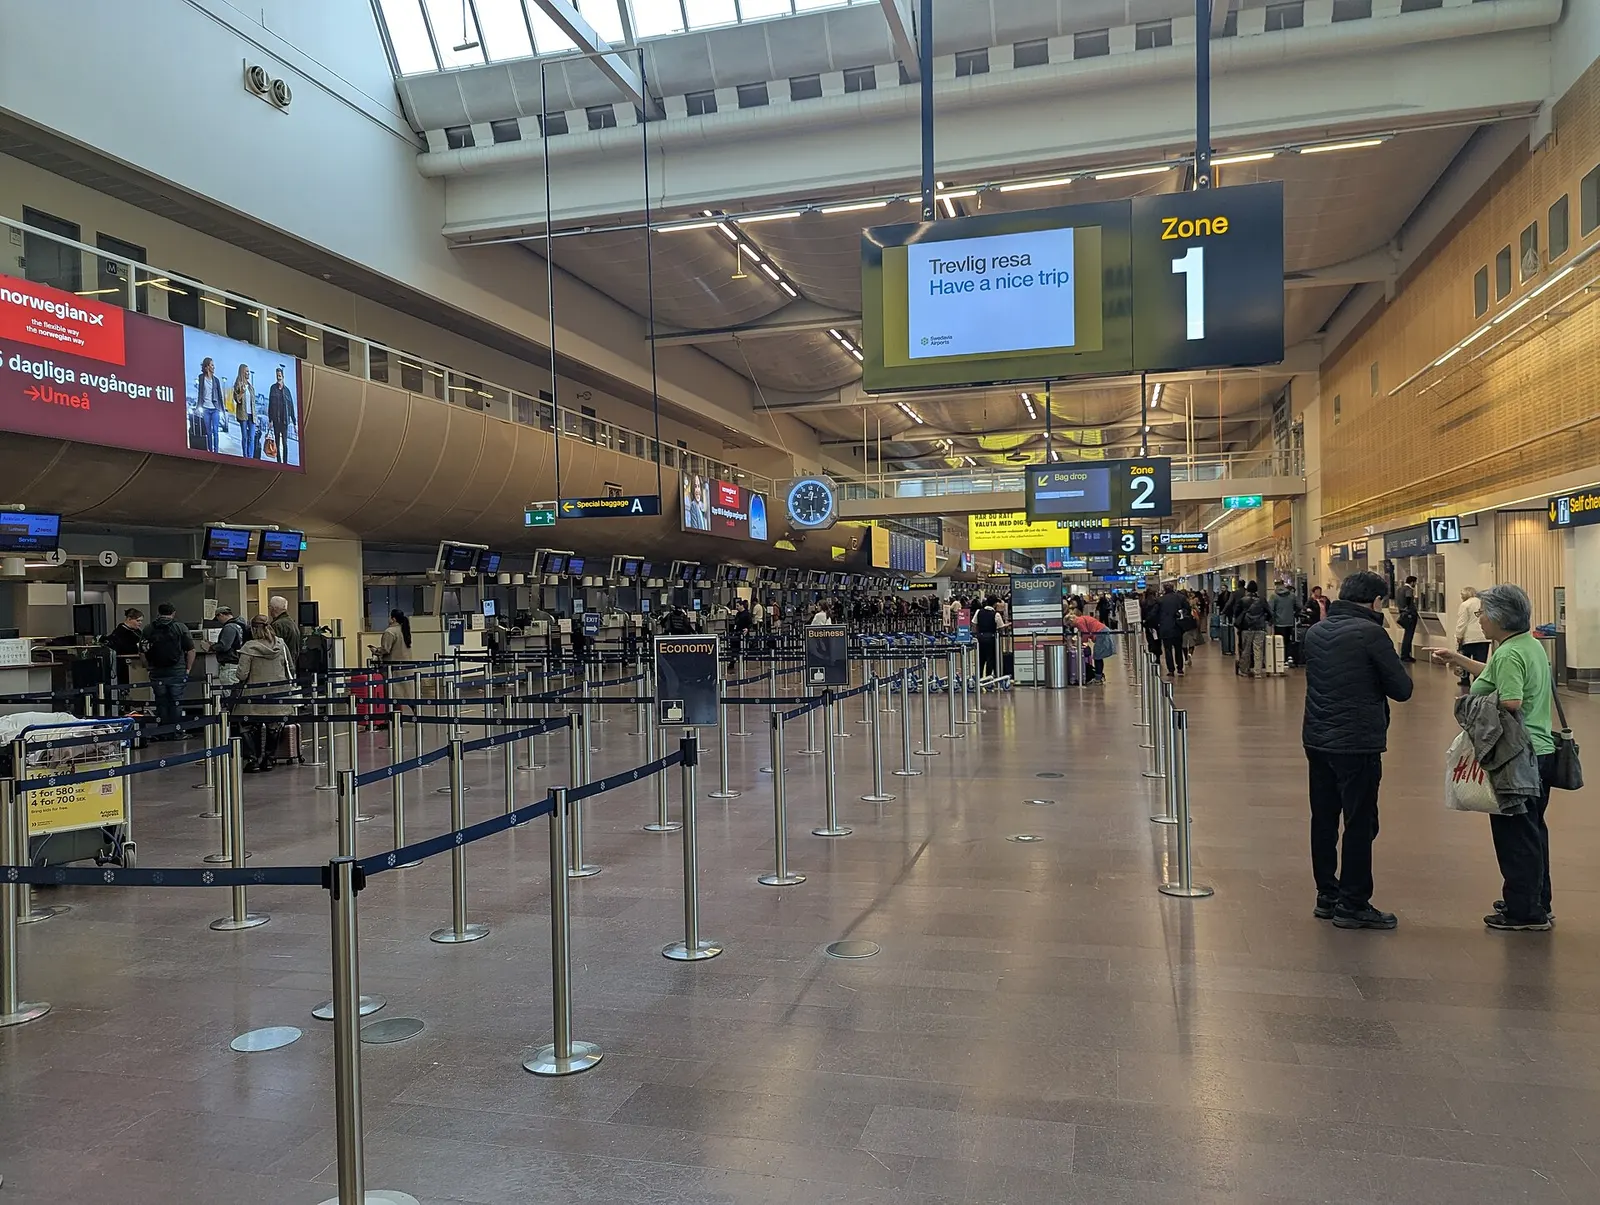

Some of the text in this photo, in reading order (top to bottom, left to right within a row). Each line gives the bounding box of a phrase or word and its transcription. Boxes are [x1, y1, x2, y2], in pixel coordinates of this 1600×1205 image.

[1161, 216, 1228, 241] Zone
[928, 252, 1032, 276] Trevlig resa
[929, 268, 1070, 297] Have a nice trip
[1171, 246, 1206, 341] 1
[0, 288, 88, 323] norwegian
[26, 325, 85, 347] the norwegian way
[31, 318, 80, 338] the flexible way
[8, 353, 76, 385] dagliga
[79, 373, 154, 400] avgångar
[155, 385, 175, 403] till
[39, 384, 91, 411] Umeå
[1054, 472, 1087, 483] Bag drop
[1130, 466, 1154, 475] Zone
[1130, 476, 1156, 510] 2
[576, 498, 643, 513] Special baggage A
[1570, 495, 1585, 513] Self
[1121, 534, 1136, 552] 3
[51, 551, 60, 563] 4
[104, 553, 113, 565] 5
[284, 561, 290, 570] 6
[1118, 558, 1127, 567] 4
[1014, 579, 1055, 591] Bagdrop
[808, 628, 844, 638] Business
[659, 642, 715, 655] Economy
[1452, 755, 1485, 786] H&M
[39, 790, 54, 798] for
[56, 786, 75, 796] 580
[40, 798, 55, 806] for
[57, 795, 75, 804] 700
